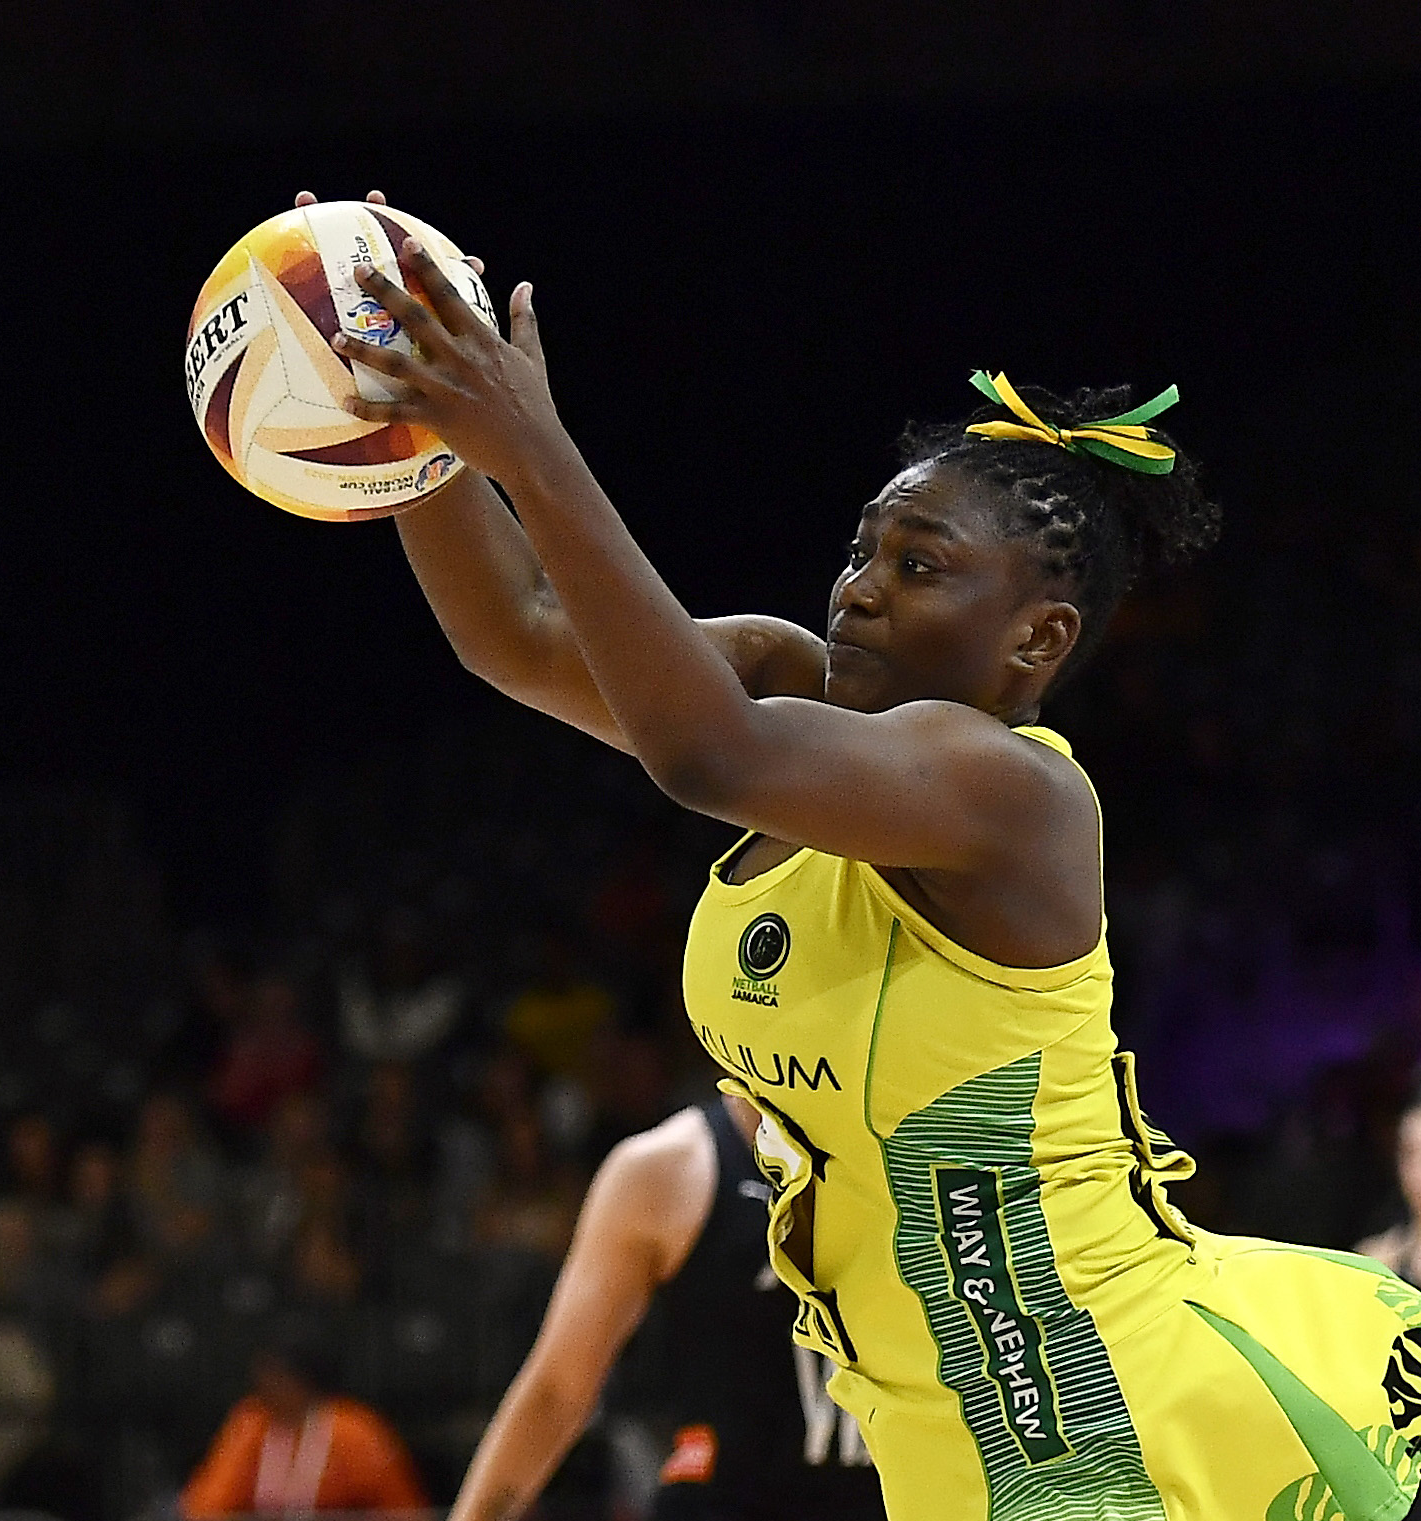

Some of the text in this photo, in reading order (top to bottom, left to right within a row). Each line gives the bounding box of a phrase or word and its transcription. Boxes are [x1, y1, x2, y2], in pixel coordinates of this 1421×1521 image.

[339, 481, 366, 490] CUP
[731, 976, 780, 996] NETBALL
[730, 988, 779, 1008] JAMAICA
[962, 1277, 996, 1307] &
[982, 1307, 1049, 1441] NEPHEW
